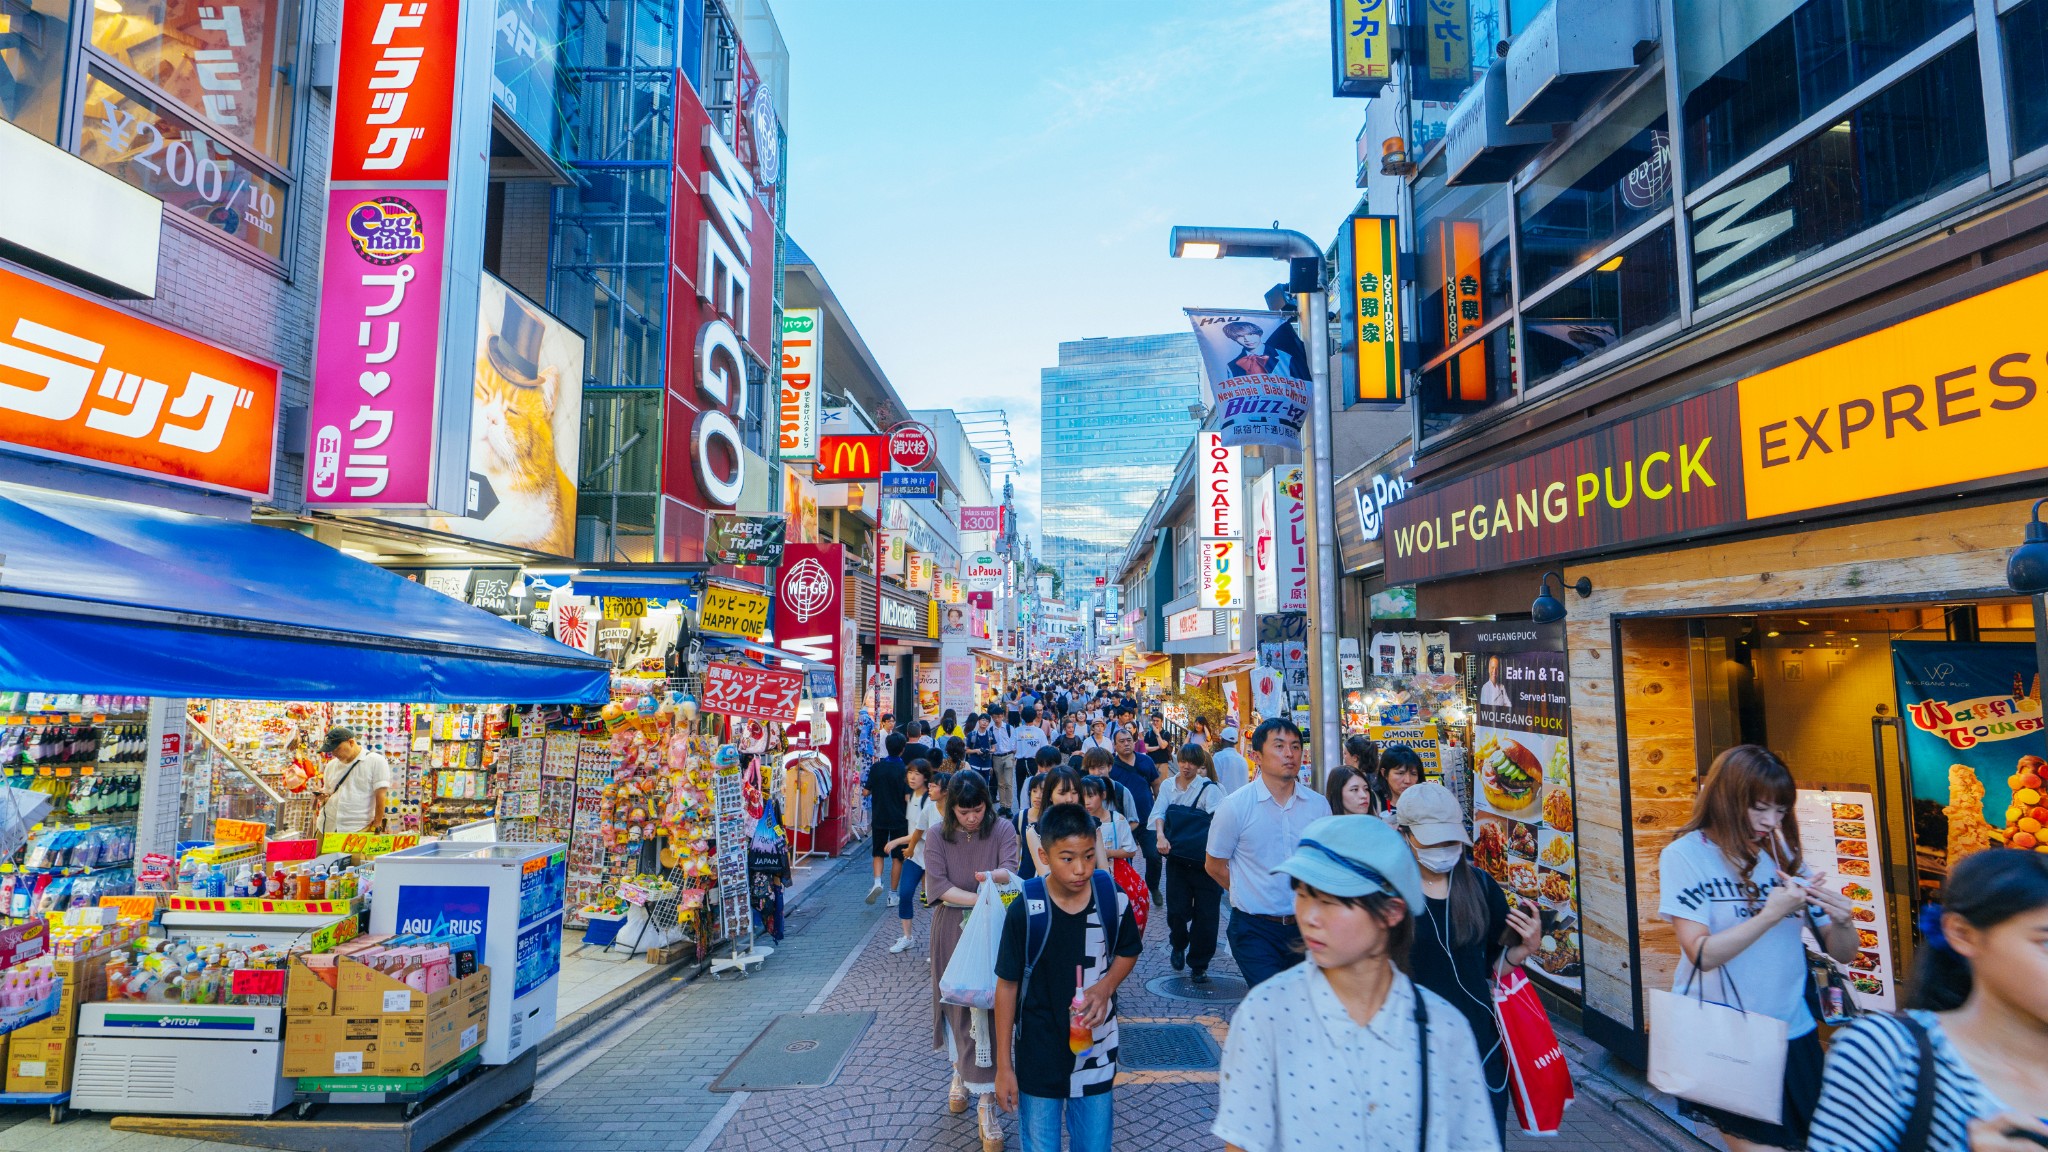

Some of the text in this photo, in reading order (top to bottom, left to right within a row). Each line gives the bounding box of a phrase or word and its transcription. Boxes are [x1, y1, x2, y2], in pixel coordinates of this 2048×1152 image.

[1350, 63, 1385, 77] 3F
[361, 3, 424, 170] ドラッグ
[244, 211, 273, 234] min
[350, 205, 413, 238] egg
[366, 232, 421, 250] nam
[692, 122, 754, 506] WEGO
[1360, 272, 1381, 344] 吉野家
[1218, 390, 1234, 403] New
[1235, 386, 1259, 396] single
[1757, 351, 2048, 470] EXPRES
[318, 437, 339, 454] B1
[893, 440, 926, 455] 消火栓
[321, 456, 334, 469] F
[1393, 435, 1718, 559] WOLFGANG PUCK
[1211, 479, 1230, 537] CAFE
[723, 521, 763, 535] LASER
[963, 517, 994, 530] ¥300
[730, 537, 763, 550] TRAP
[768, 544, 783, 555] 3F
[968, 565, 1003, 577] La Pausa
[1203, 543, 1212, 590] PURIKURA
[1213, 541, 1233, 607] プリクラ
[475, 578, 509, 599] 日本
[605, 602, 644, 618] ¥1000
[706, 593, 767, 615] ハッピーワン
[600, 629, 630, 639] TOKYO
[702, 615, 764, 636] HAPPY ONE
[1477, 631, 1537, 642] WOLFGANG PUCK
[709, 667, 801, 690] 原宿ハッピーワン
[1505, 666, 1564, 682] Eat in & Ta
[706, 679, 799, 710] スクイーズ
[1519, 691, 1566, 704] Served 11am
[703, 698, 796, 719] SQUEEZE
[1909, 698, 2039, 731] Waffle
[1481, 710, 1563, 730] WOLFGANG PUCK
[1392, 730, 1425, 738] MONEY
[1941, 716, 2045, 748] Tower
[1377, 739, 1437, 749] EXCHANGE
[401, 909, 483, 937] AQUARIUS
[170, 1018, 200, 1027] ITO EN
